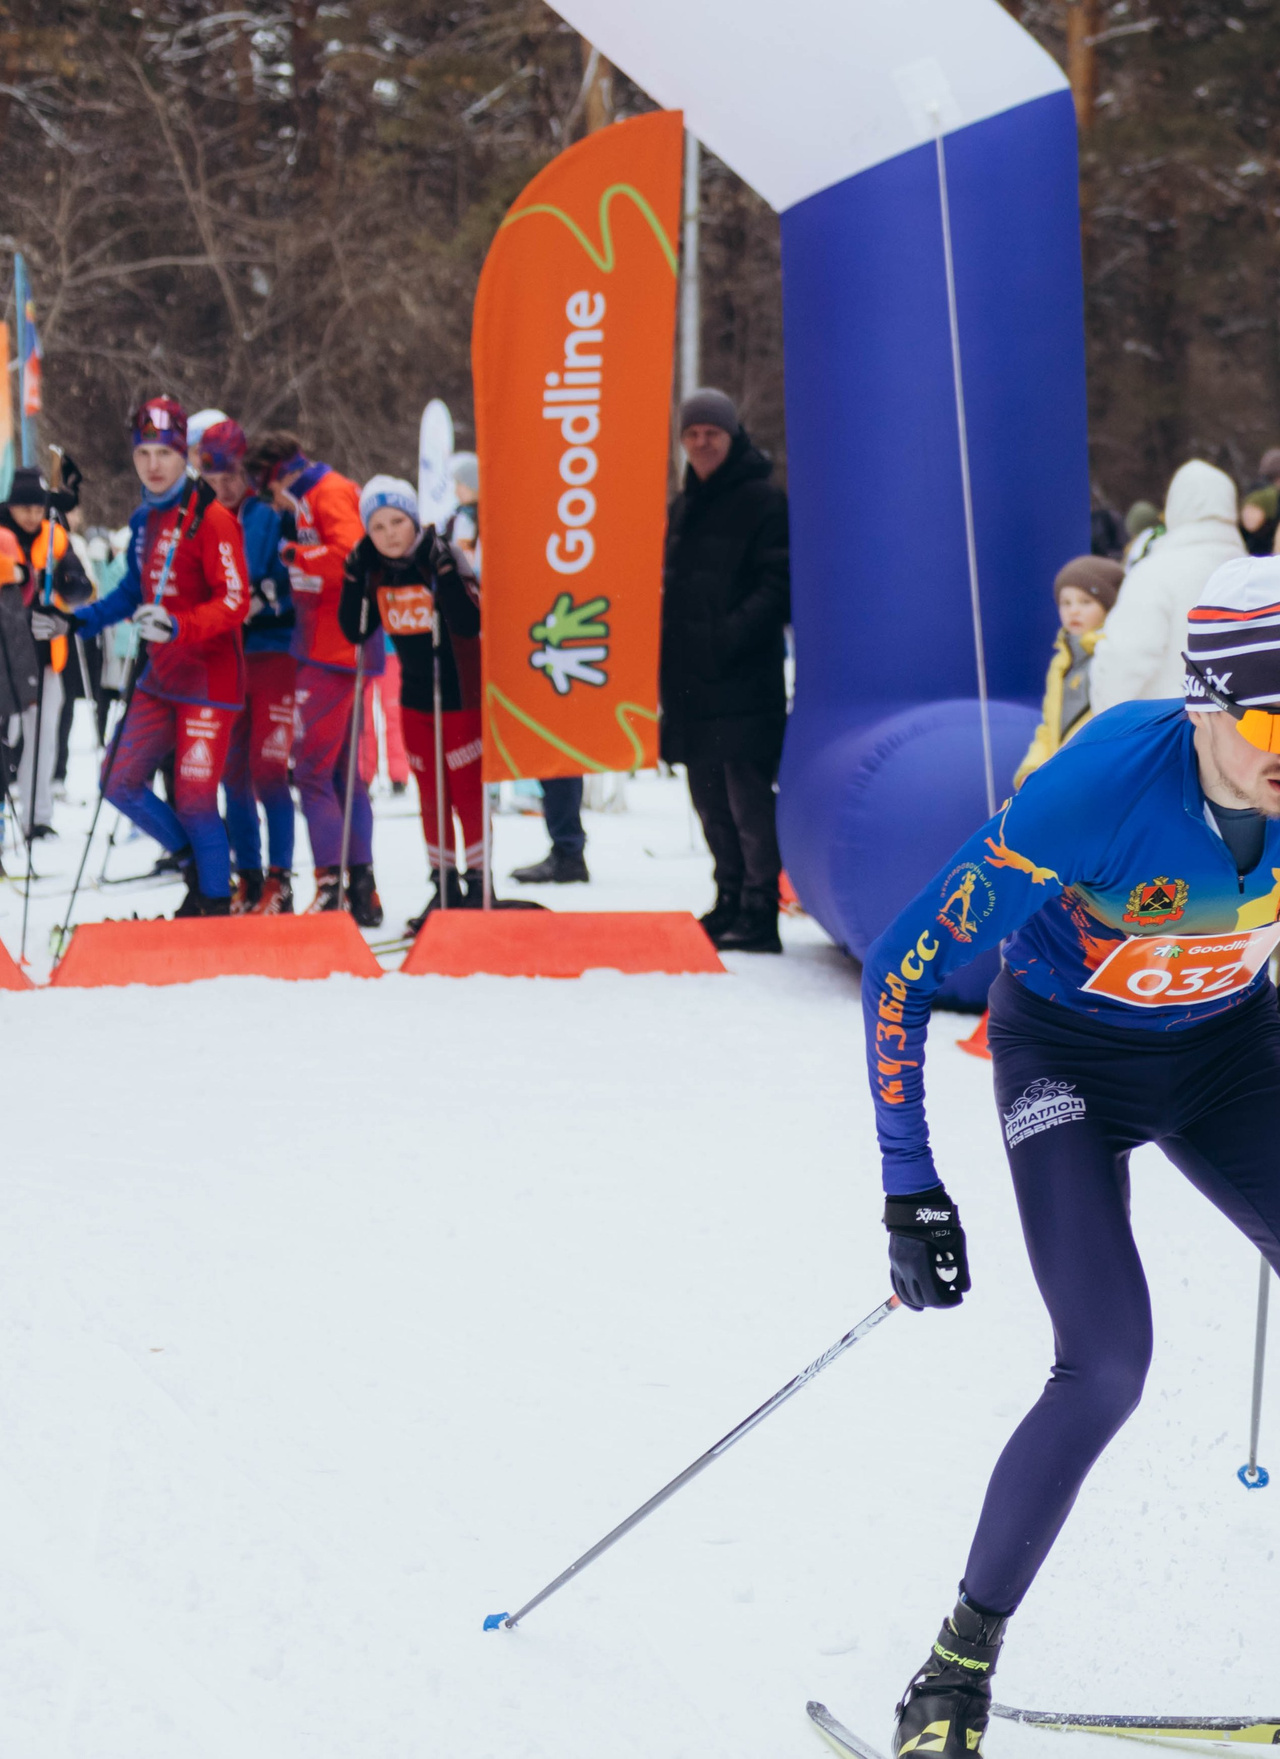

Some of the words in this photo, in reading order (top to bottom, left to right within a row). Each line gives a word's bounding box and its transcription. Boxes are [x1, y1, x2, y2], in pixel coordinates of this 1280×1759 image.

[543, 290, 606, 575] Goodline
[1126, 961, 1245, 997] 032
[1007, 1100, 1083, 1136] ТРИАТЛОН
[1008, 1112, 1086, 1149] КУЗБАСС
